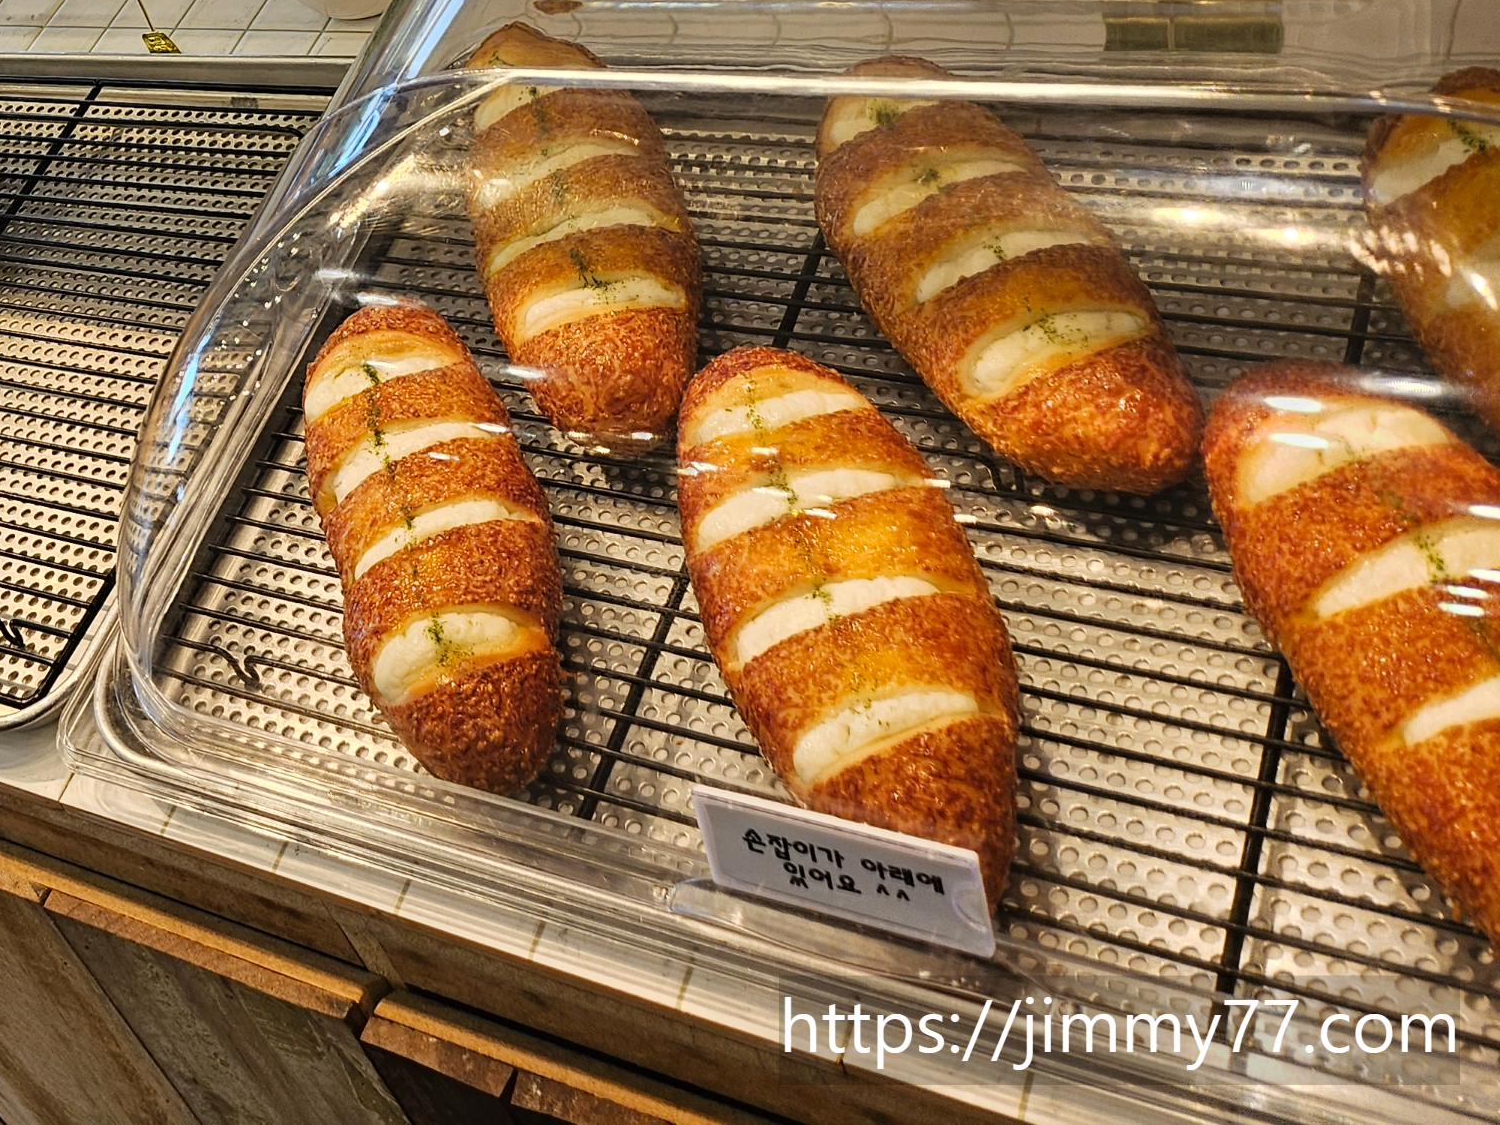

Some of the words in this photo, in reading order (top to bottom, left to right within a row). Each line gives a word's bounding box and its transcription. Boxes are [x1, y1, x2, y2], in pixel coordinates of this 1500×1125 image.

[742, 828, 845, 869] 손잡이가
[861, 857, 946, 895] 아래에
[783, 862, 862, 895] 있어요
